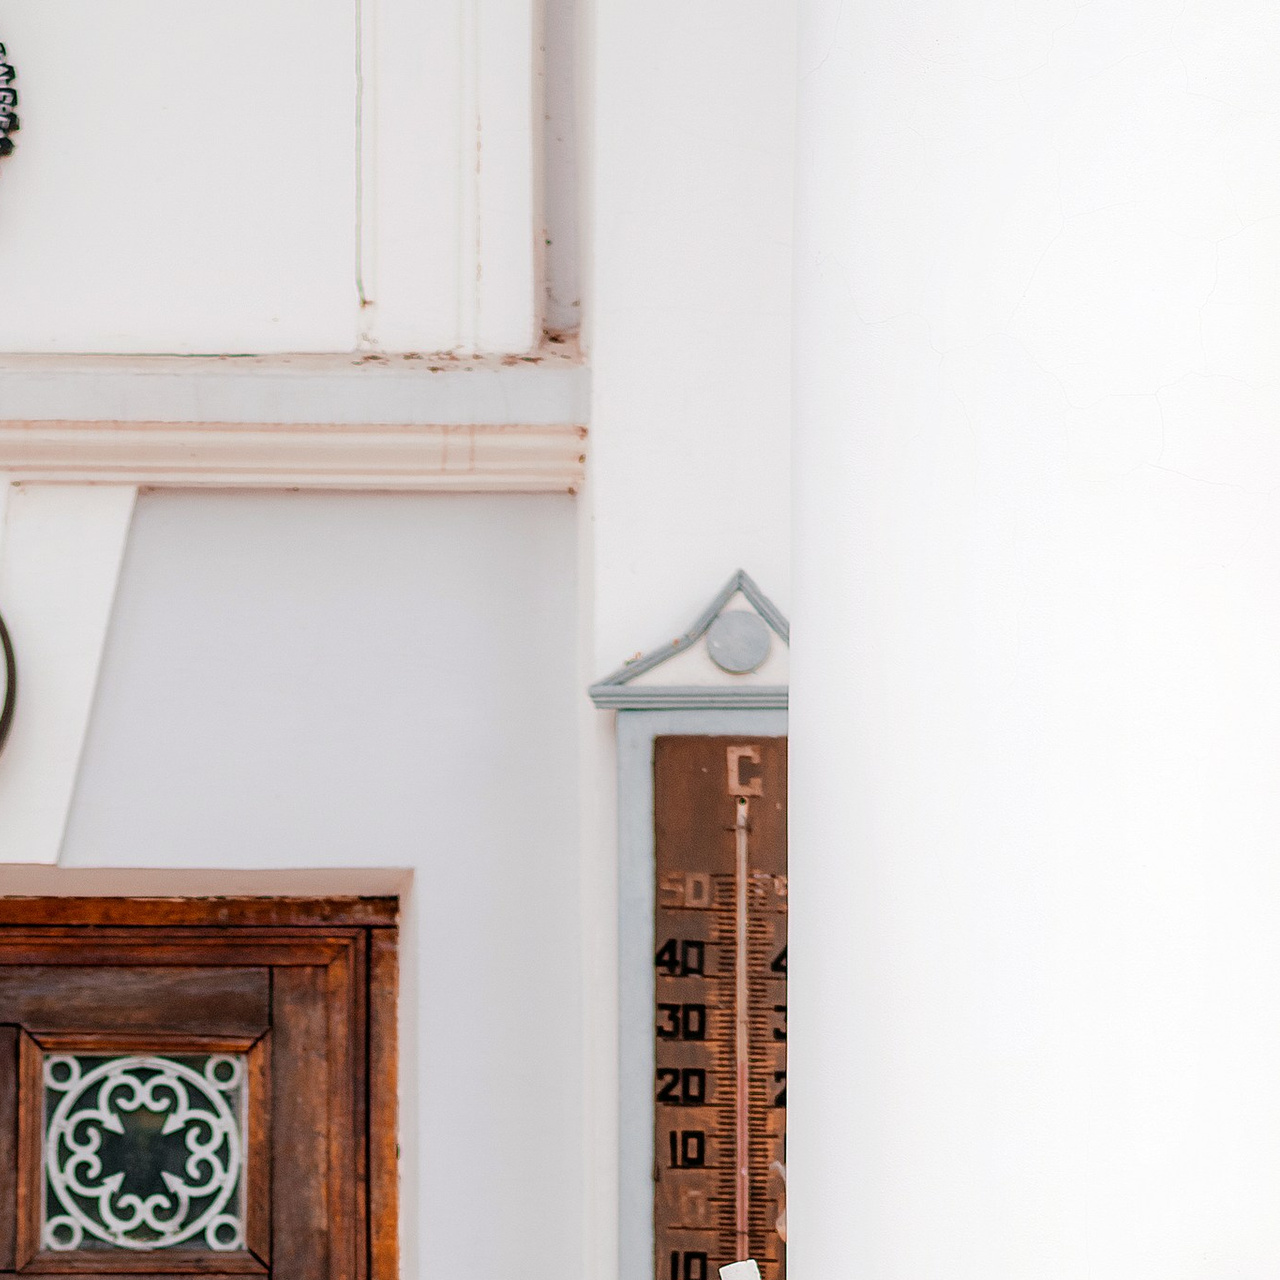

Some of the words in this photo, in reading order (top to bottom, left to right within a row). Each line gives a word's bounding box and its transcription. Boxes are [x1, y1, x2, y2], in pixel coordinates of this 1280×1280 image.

[655, 938, 705, 977] 40
[656, 1003, 706, 1040] 30
[655, 1067, 706, 1105] 20
[669, 1130, 706, 1167] 10
